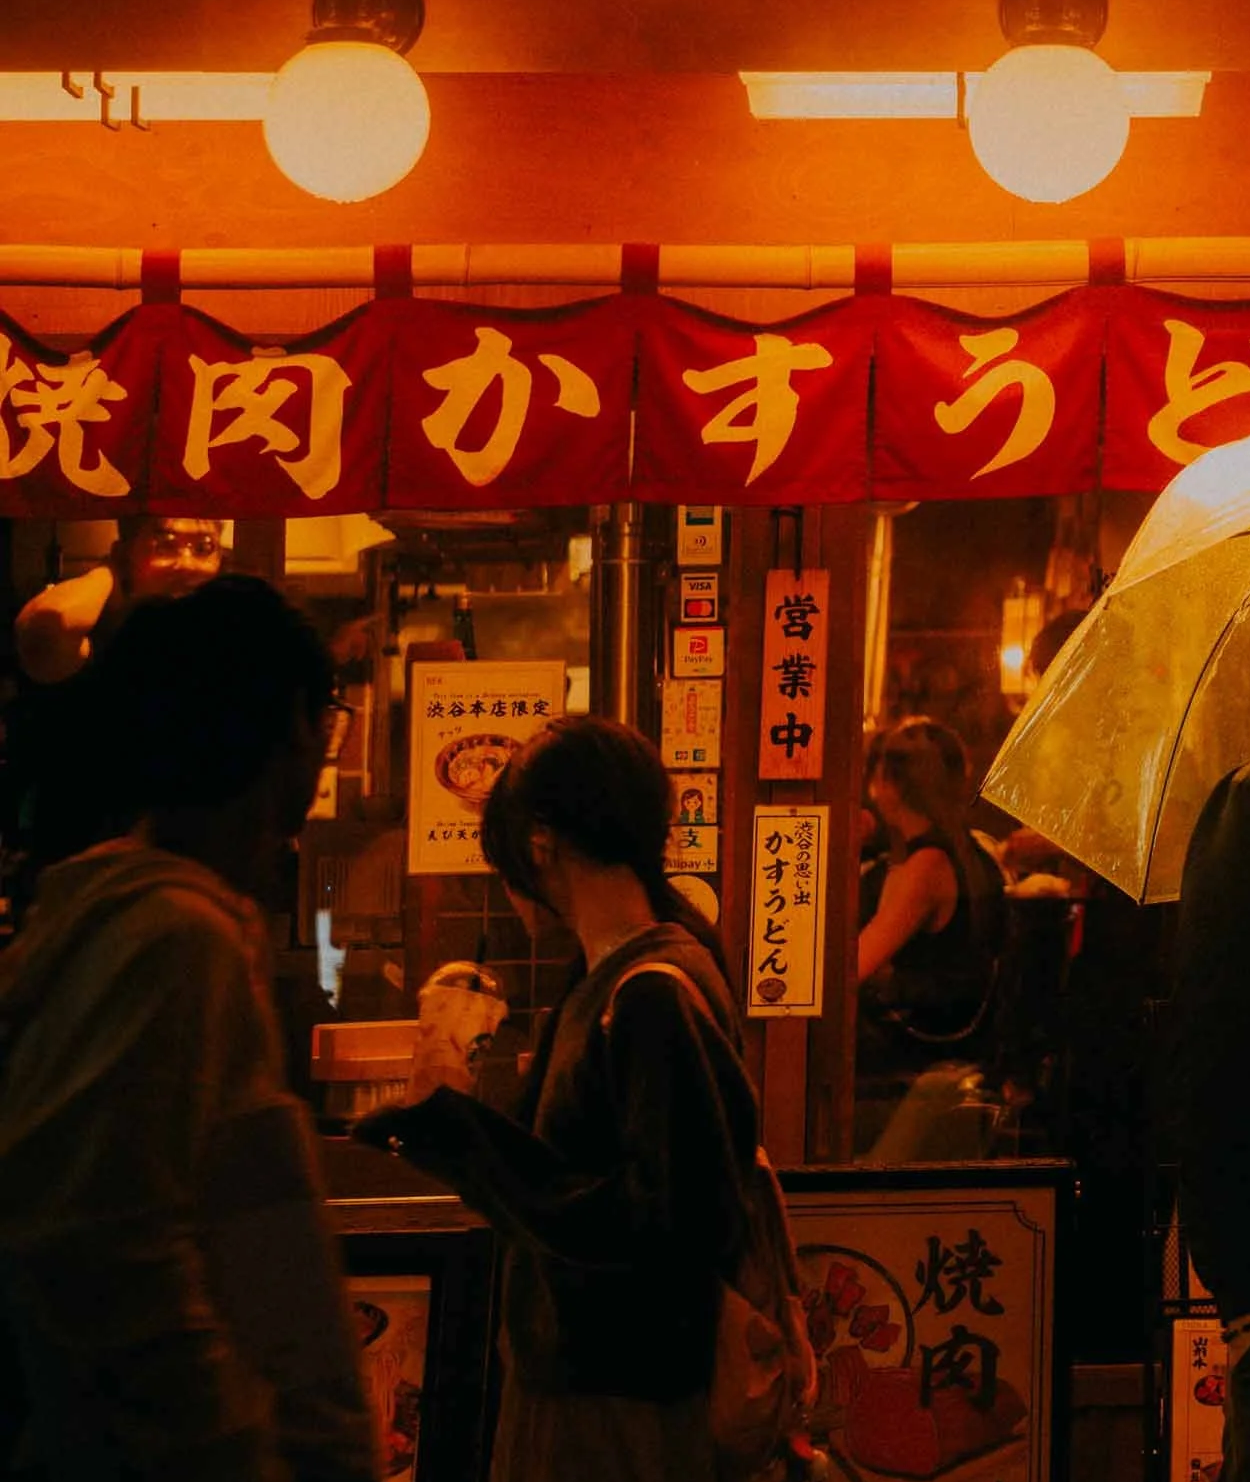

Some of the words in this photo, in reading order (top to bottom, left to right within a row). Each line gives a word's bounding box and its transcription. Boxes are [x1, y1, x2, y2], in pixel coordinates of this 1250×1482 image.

[689, 582, 712, 591] VISA
[426, 699, 551, 719] 渋谷本店限定
[768, 593, 821, 760] 営業中
[757, 830, 794, 976] かすうどん
[791, 821, 816, 907] 渋谷の思い出
[913, 1228, 1006, 1413] 焼肉
